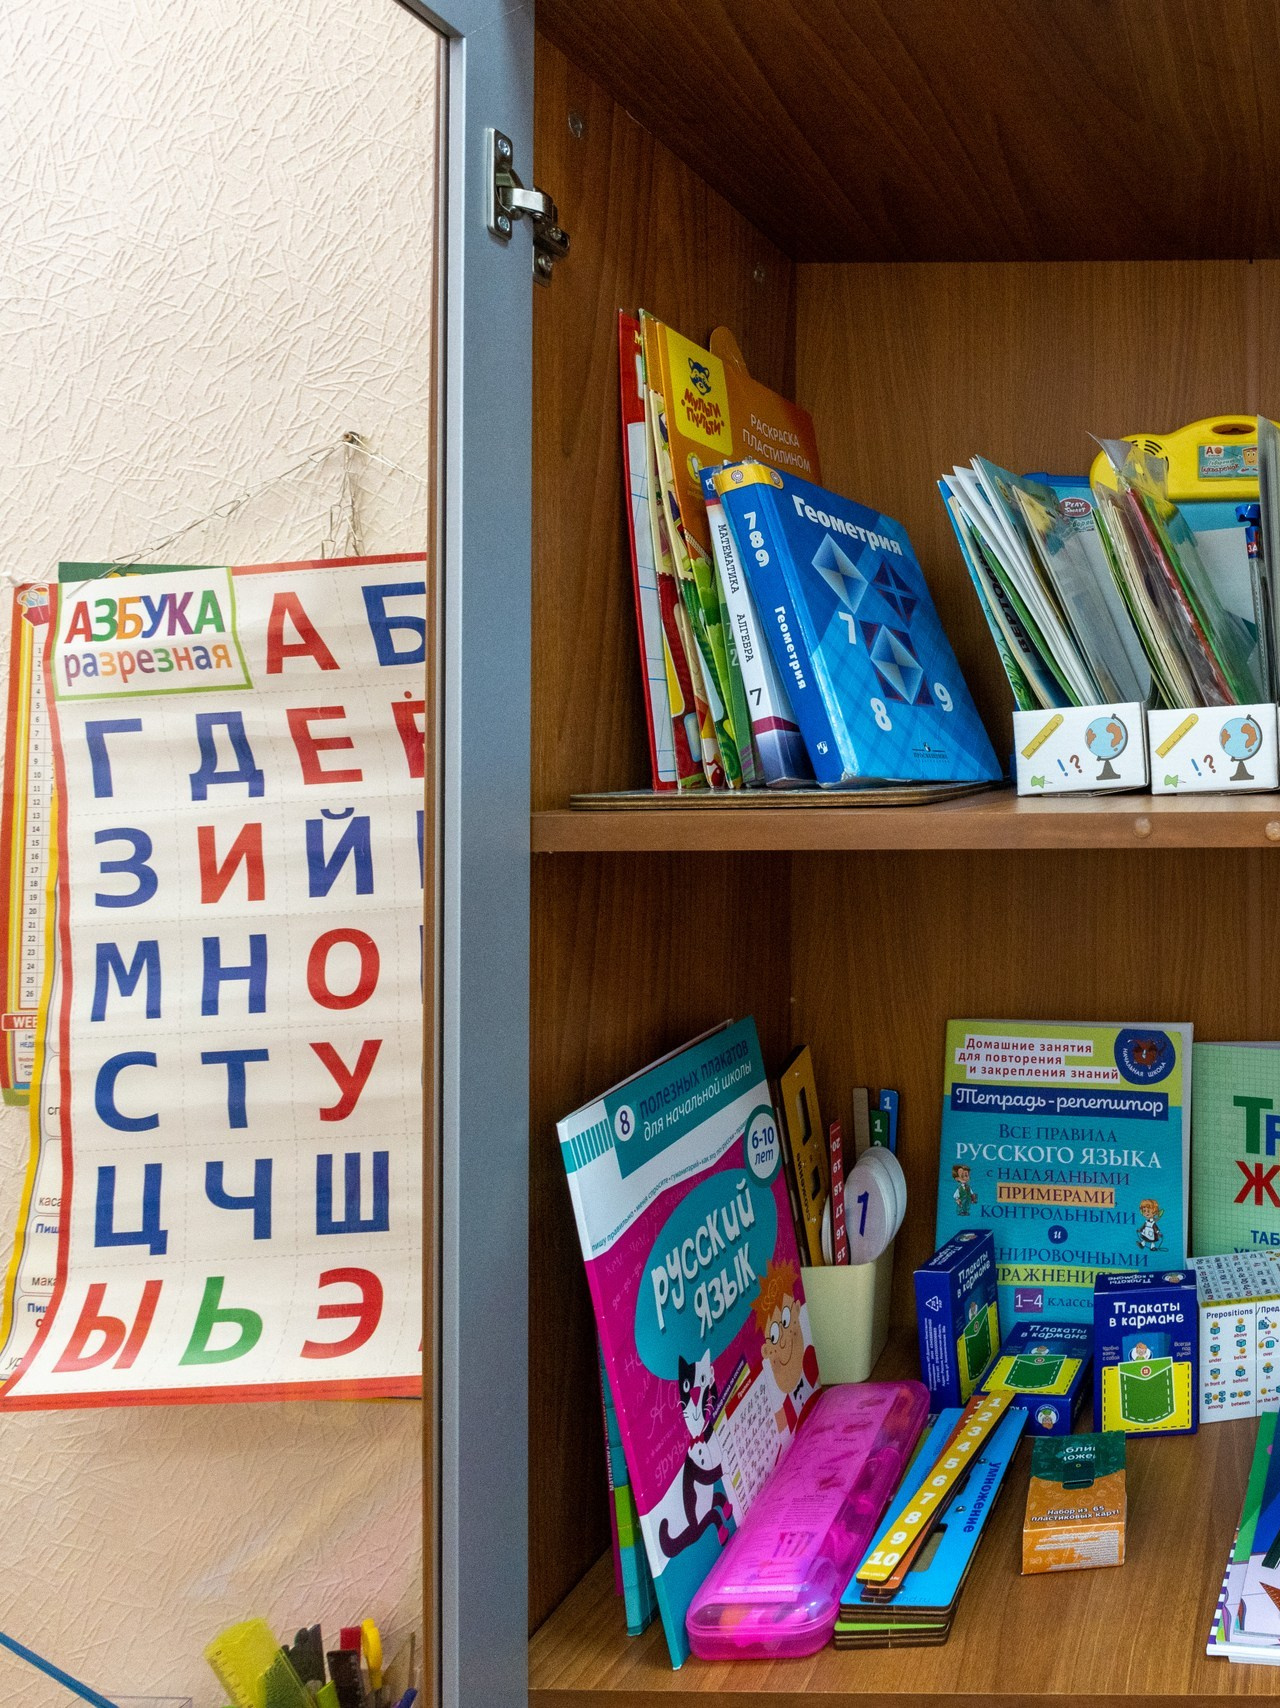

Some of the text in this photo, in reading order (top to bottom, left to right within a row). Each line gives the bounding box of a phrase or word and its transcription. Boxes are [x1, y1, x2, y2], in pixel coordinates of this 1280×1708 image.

[684, 388, 721, 419] МУЛЬТИ
[686, 408, 721, 436] ПУЛЬТИ
[750, 413, 801, 448] РАСКРАСКА
[742, 428, 812, 474] ПЛАСТИЛИНОМ
[744, 511, 757, 530] 7
[791, 494, 904, 557] Геометрия
[749, 531, 765, 548] 8
[755, 550, 770, 568] 9
[64, 589, 226, 644] АЗБУКА
[718, 524, 762, 706] МАТЕМАТИКА АЛГЕБРА 7
[266, 582, 426, 675] А Б
[838, 612, 858, 645] 7
[774, 606, 807, 690] Геометрия
[64, 644, 233, 687] разрезная
[933, 682, 954, 712] 9
[870, 698, 892, 732] 8
[85, 706, 363, 801] Г Д Е
[94, 807, 374, 908] З И Й
[90, 928, 380, 1022] М Н О
[966, 1038, 1093, 1054] Домашние занятия
[958, 1052, 1062, 1065] для повторения
[1123, 1048, 1166, 1077] НАЧАЛЬНАЯ ШКОЛА
[969, 1066, 1120, 1081] и закрепления знаний
[94, 1039, 383, 1132] С Т У
[620, 1039, 749, 1135] 8 полезных плакатов
[643, 1061, 752, 1141] для начальной школы
[884, 1097, 892, 1110] 1
[752, 1126, 774, 1149] 6-10
[874, 1119, 883, 1133] 1
[1036, 1126, 1118, 1143] ПРАВИЛА
[754, 1148, 774, 1165] лет
[955, 1142, 1162, 1169] РУССКОГО ЯЗЫКА
[996, 1167, 1130, 1185] НАГЛЯДНЫМИ
[94, 1151, 390, 1256] Ц Ч Ш
[997, 1185, 1119, 1207] ПРИМЕРАМИ,
[857, 1190, 869, 1237] 1
[980, 1204, 1136, 1225] КОНТРОЛЬНЫМИ
[1053, 1230, 1062, 1239] и
[651, 1178, 755, 1331] русский
[958, 1251, 989, 1283] Плакаты
[963, 1261, 990, 1292] кармане
[694, 1244, 757, 1338] язык
[1113, 1302, 1180, 1314] Плакаты
[1206, 1309, 1253, 1319] Prepositions
[51, 1267, 384, 1374] Ы Ь Э
[1029, 1325, 1086, 1334] Плакаты
[1109, 1313, 1184, 1329] в кармане
[989, 1397, 1002, 1408] 1
[977, 1411, 989, 1422] 2
[968, 1426, 981, 1437] 3
[957, 1441, 970, 1453] 4
[944, 1458, 960, 1470] 5
[932, 1475, 947, 1487] 6
[921, 1492, 936, 1505] 7
[963, 1462, 1002, 1533] умножение
[904, 1511, 919, 1525] 8
[1032, 1513, 1092, 1522] пластиковых
[890, 1531, 907, 1545] 9
[866, 1551, 900, 1566] 10
